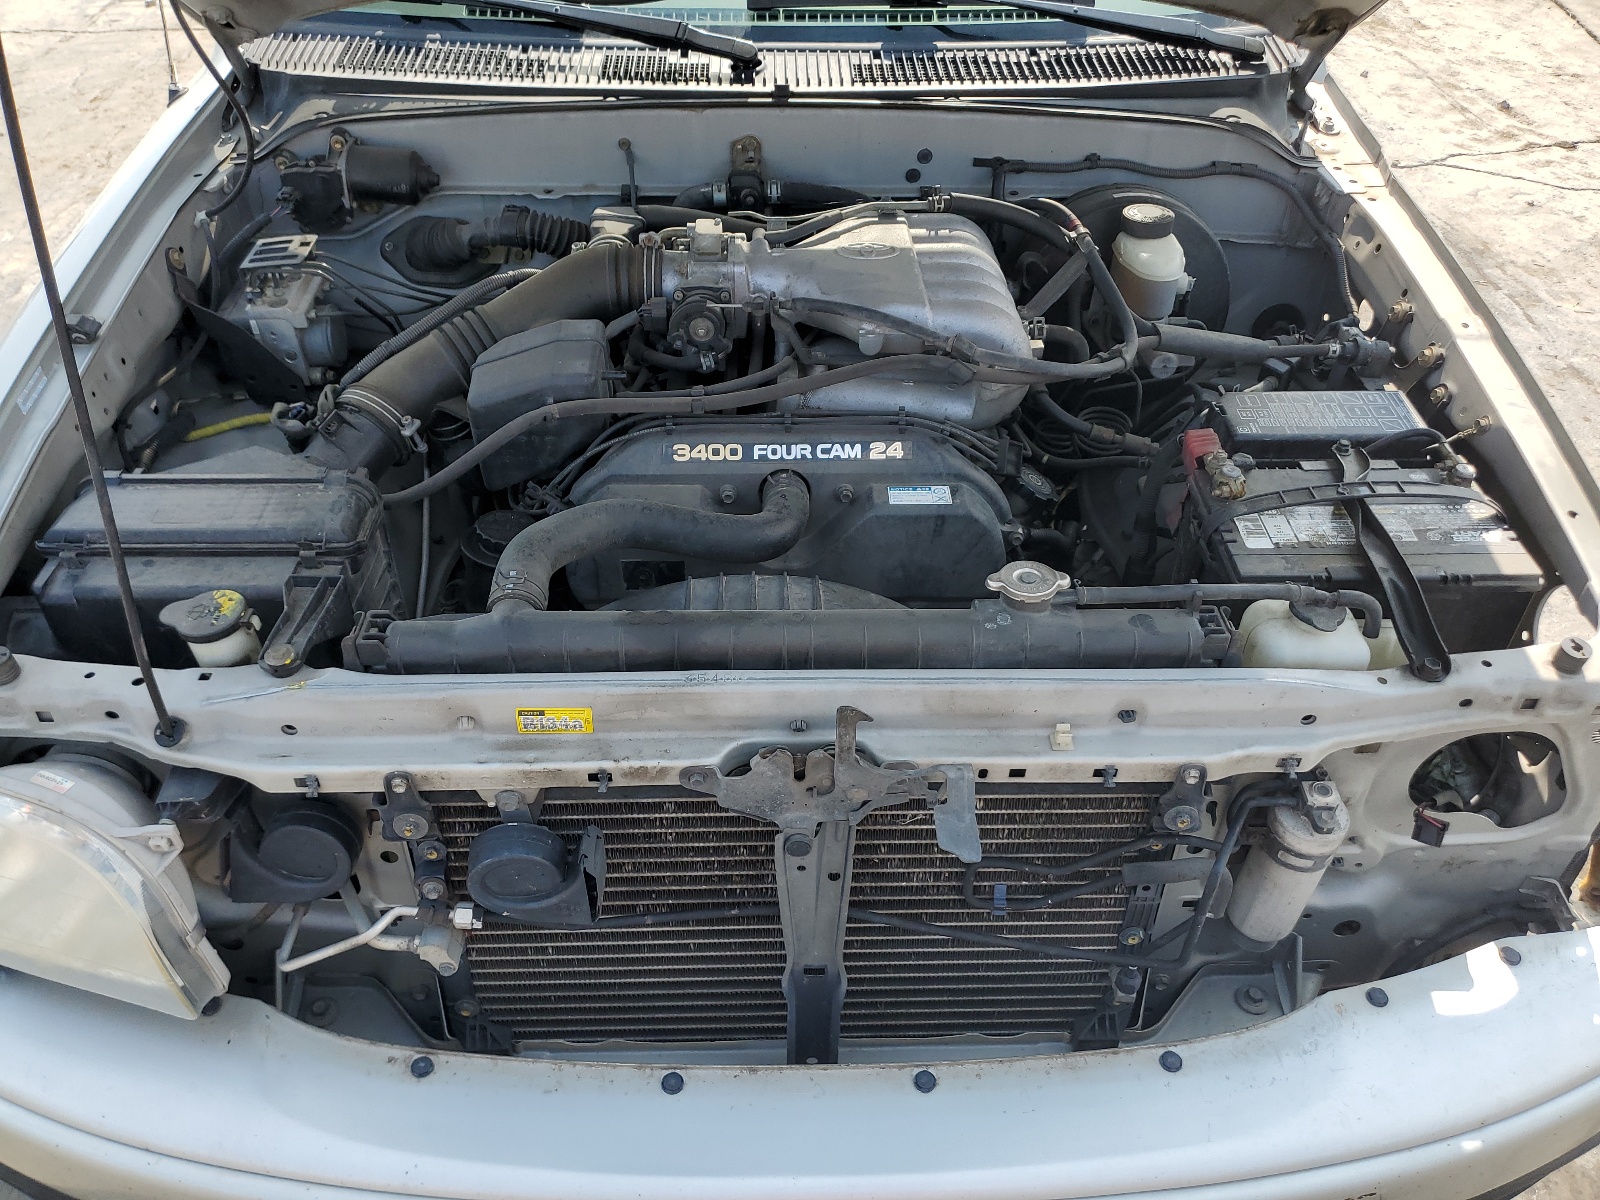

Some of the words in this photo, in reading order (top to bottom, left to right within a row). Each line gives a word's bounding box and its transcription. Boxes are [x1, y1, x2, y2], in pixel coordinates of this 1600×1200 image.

[672, 443, 742, 461] 3400
[753, 444, 811, 459] FOUR
[816, 443, 862, 459] CAM
[869, 441, 903, 460] 24
